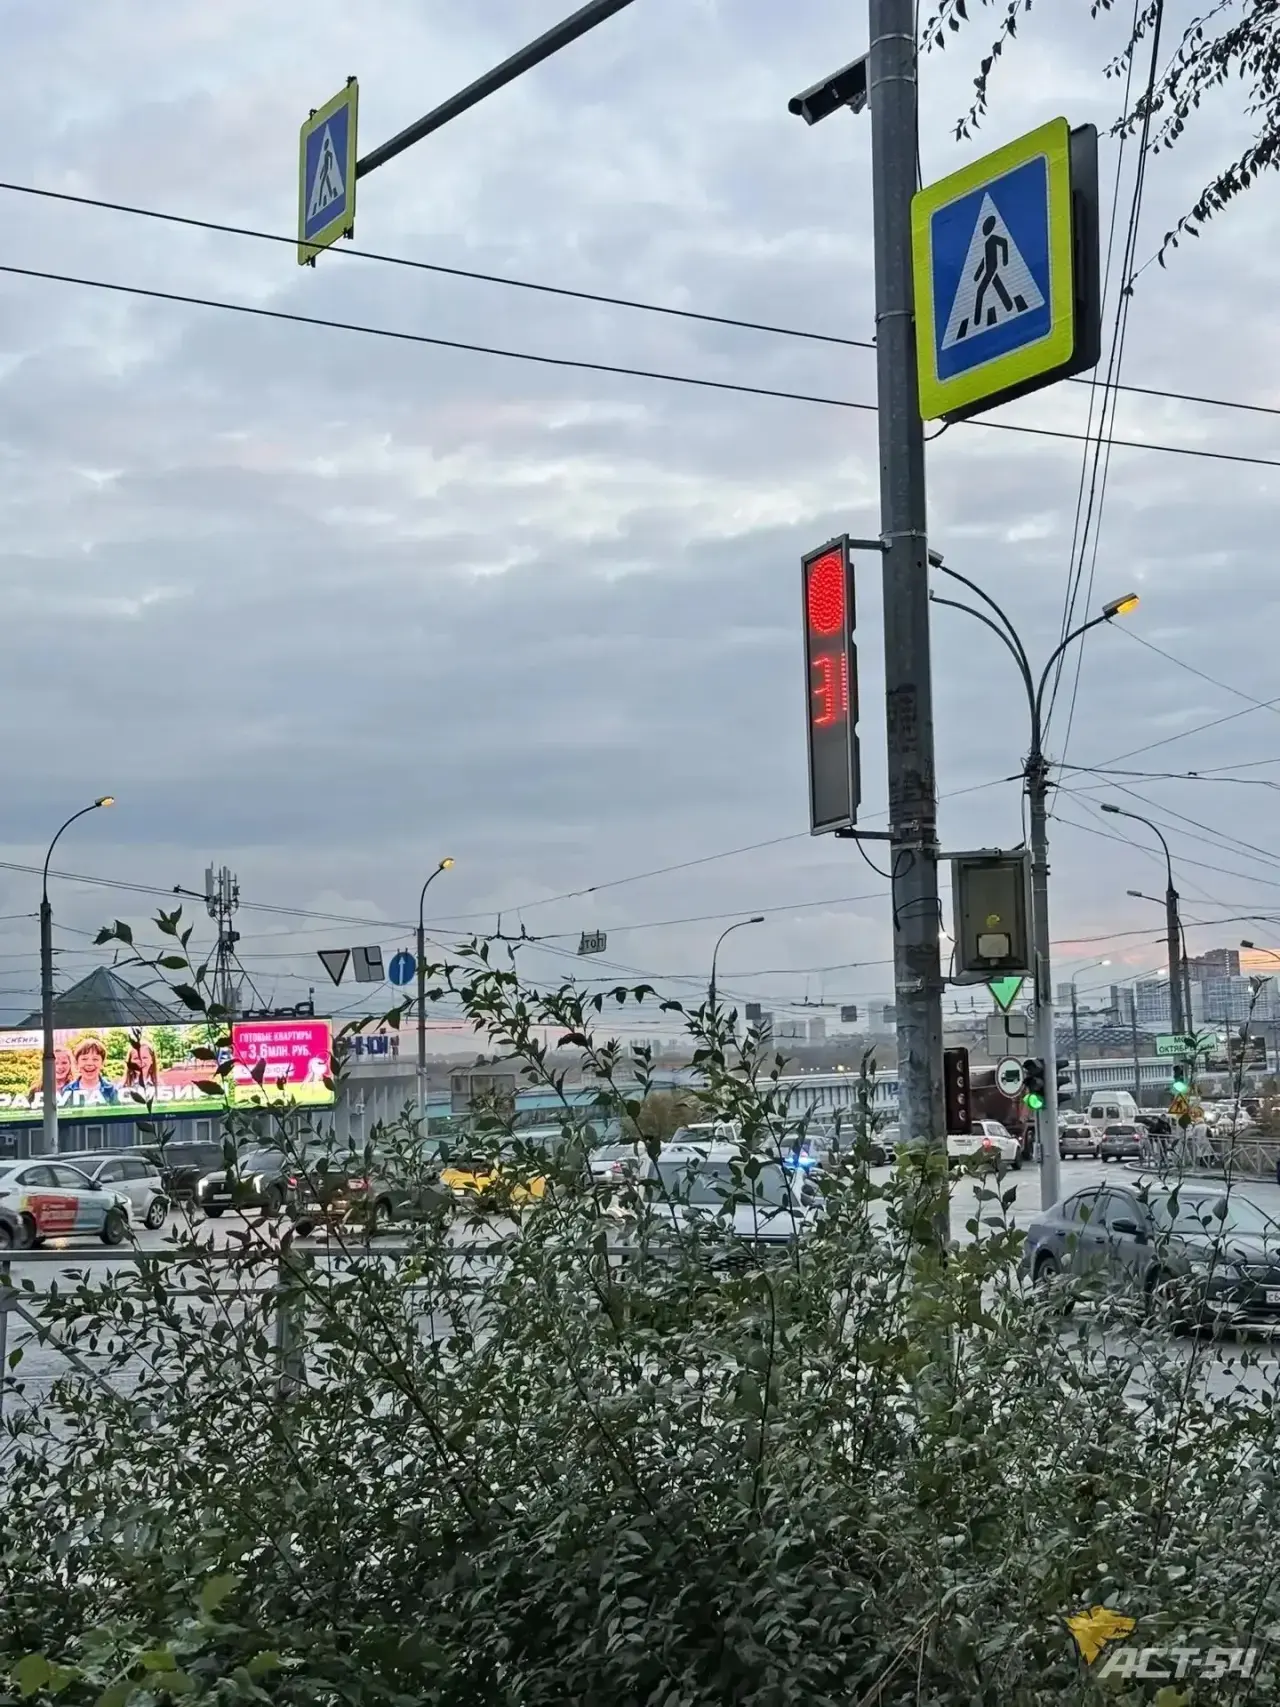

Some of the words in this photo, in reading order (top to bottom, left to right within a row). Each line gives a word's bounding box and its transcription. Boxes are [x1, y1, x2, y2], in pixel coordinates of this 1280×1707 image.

[240, 1032, 272, 1042] ГОТОВЫЕ
[274, 1031, 312, 1040] КВАРТИРЫ
[292, 1044, 311, 1056] РУБ.
